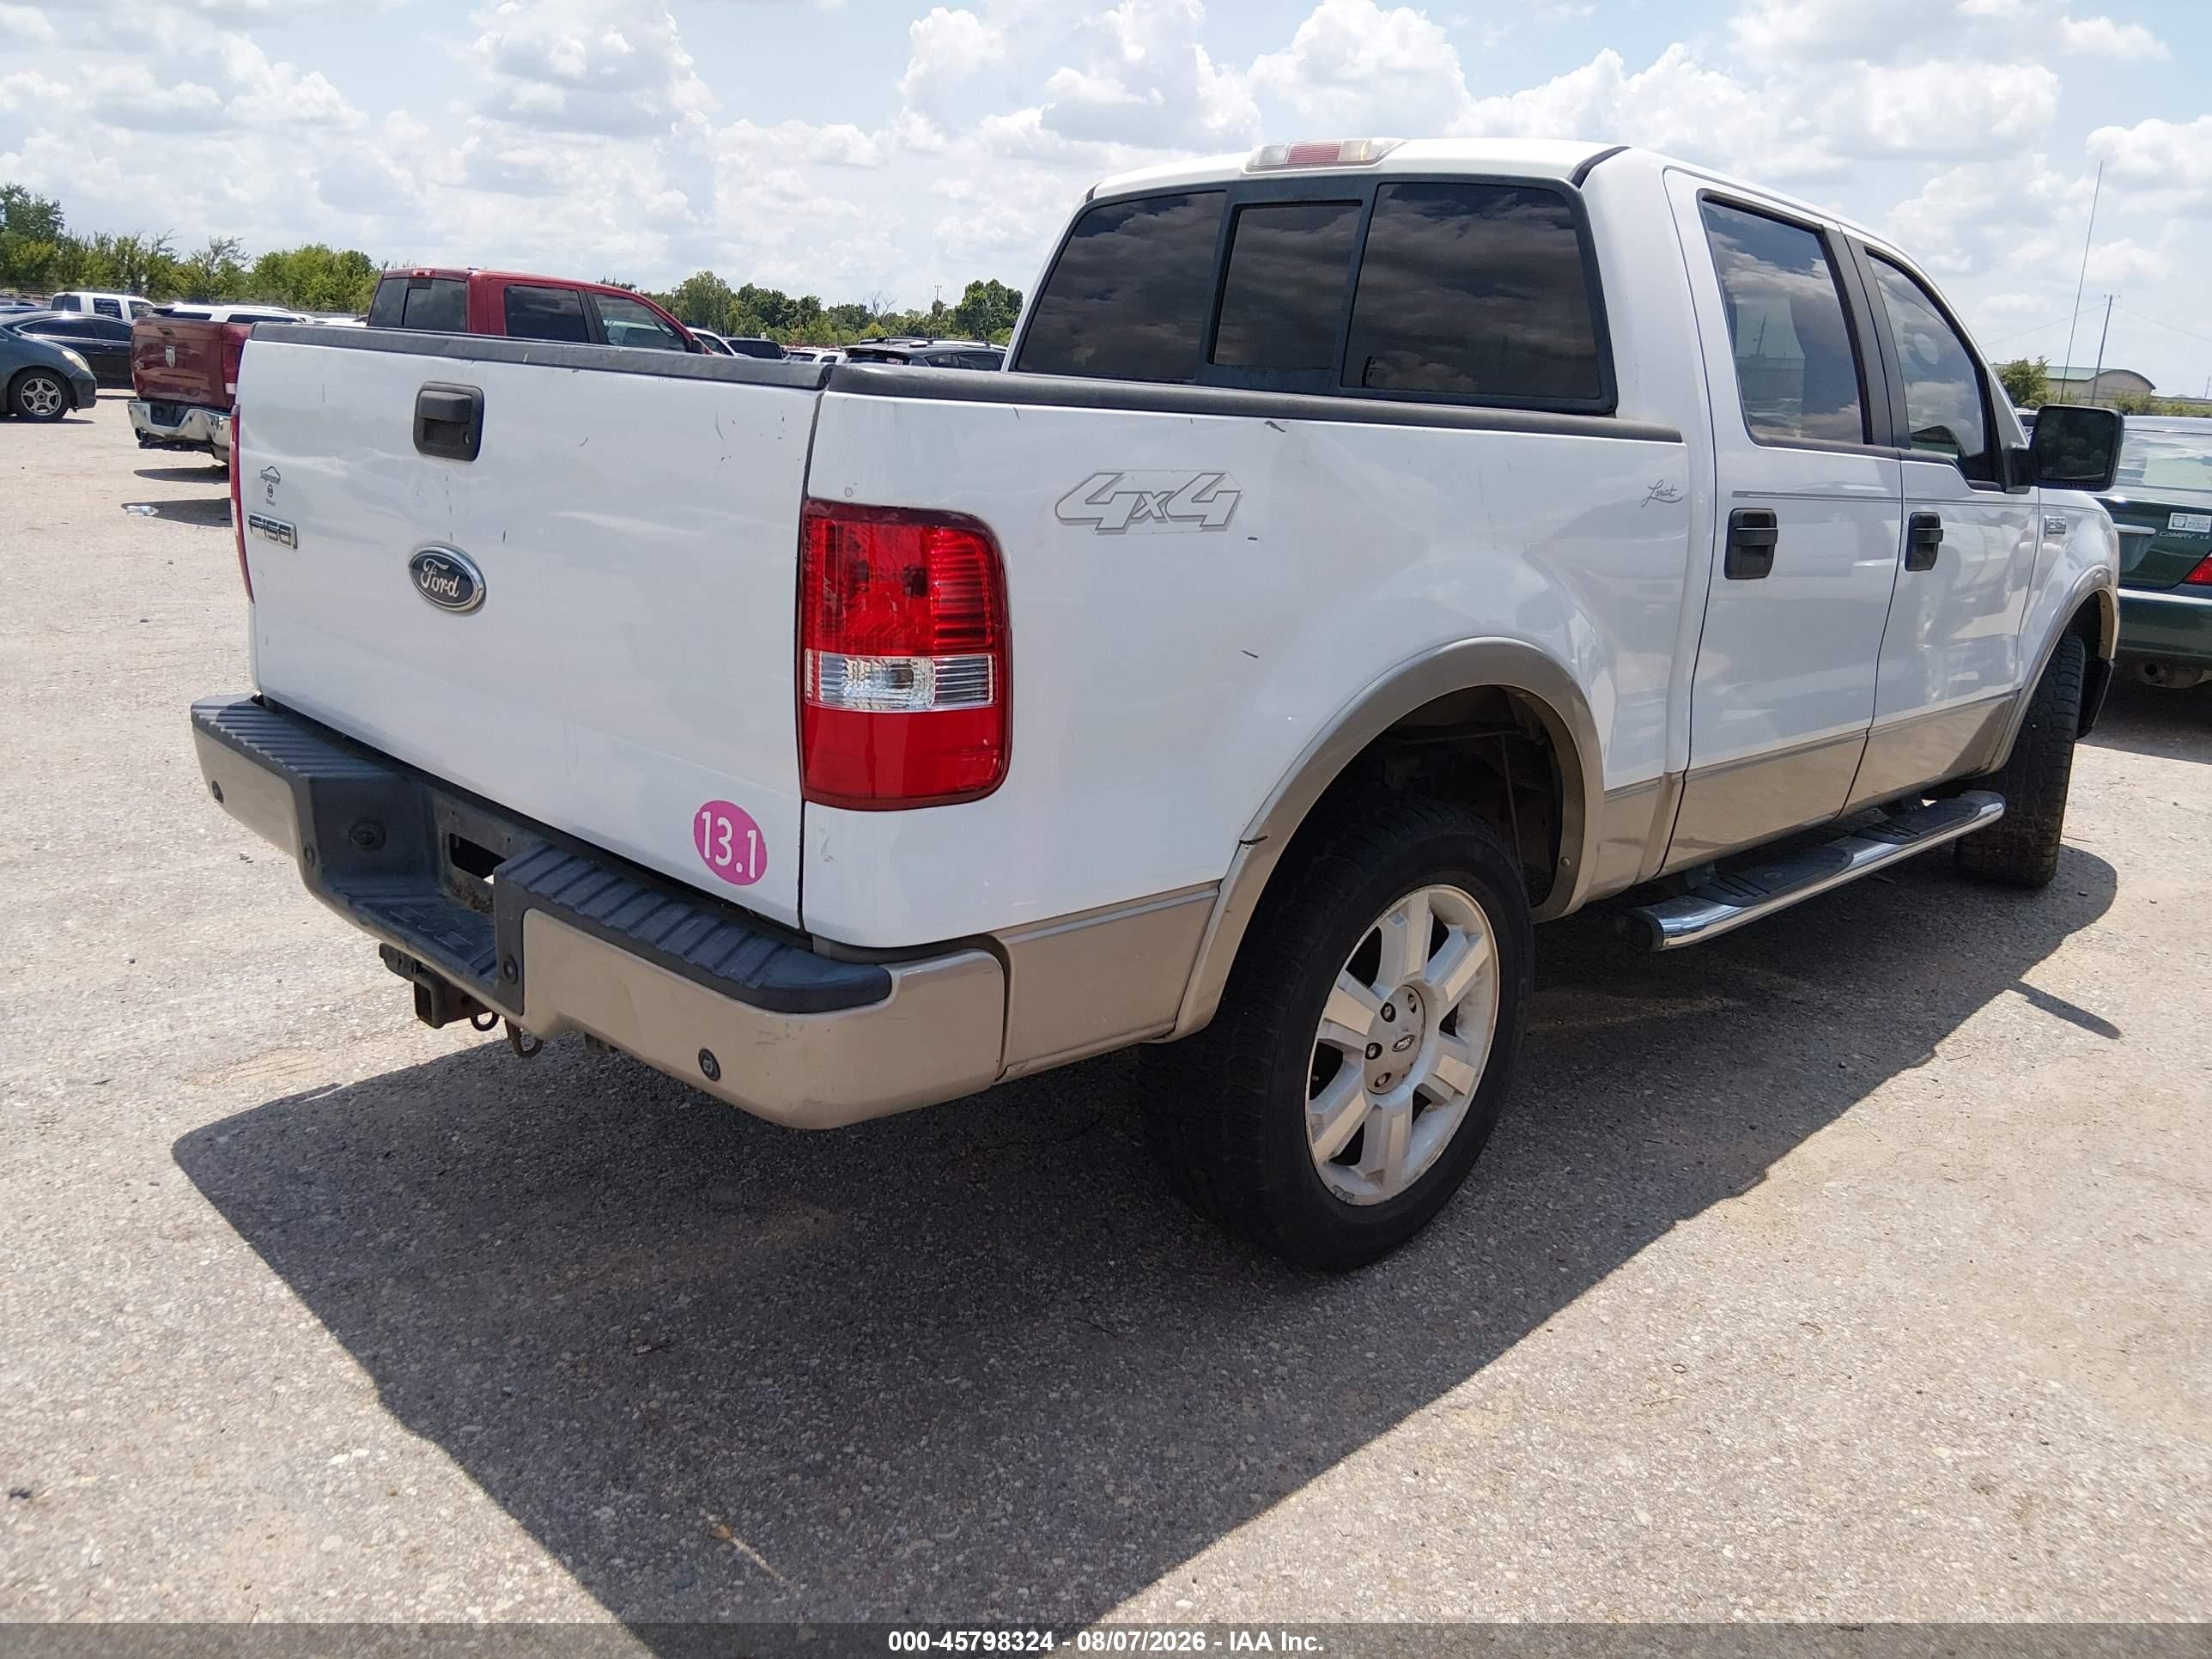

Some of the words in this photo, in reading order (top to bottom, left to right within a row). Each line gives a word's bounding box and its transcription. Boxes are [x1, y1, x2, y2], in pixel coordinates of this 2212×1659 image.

[1054, 471, 1243, 534] 4x4
[420, 558, 460, 597] Ford
[702, 811, 757, 878] 13.1
